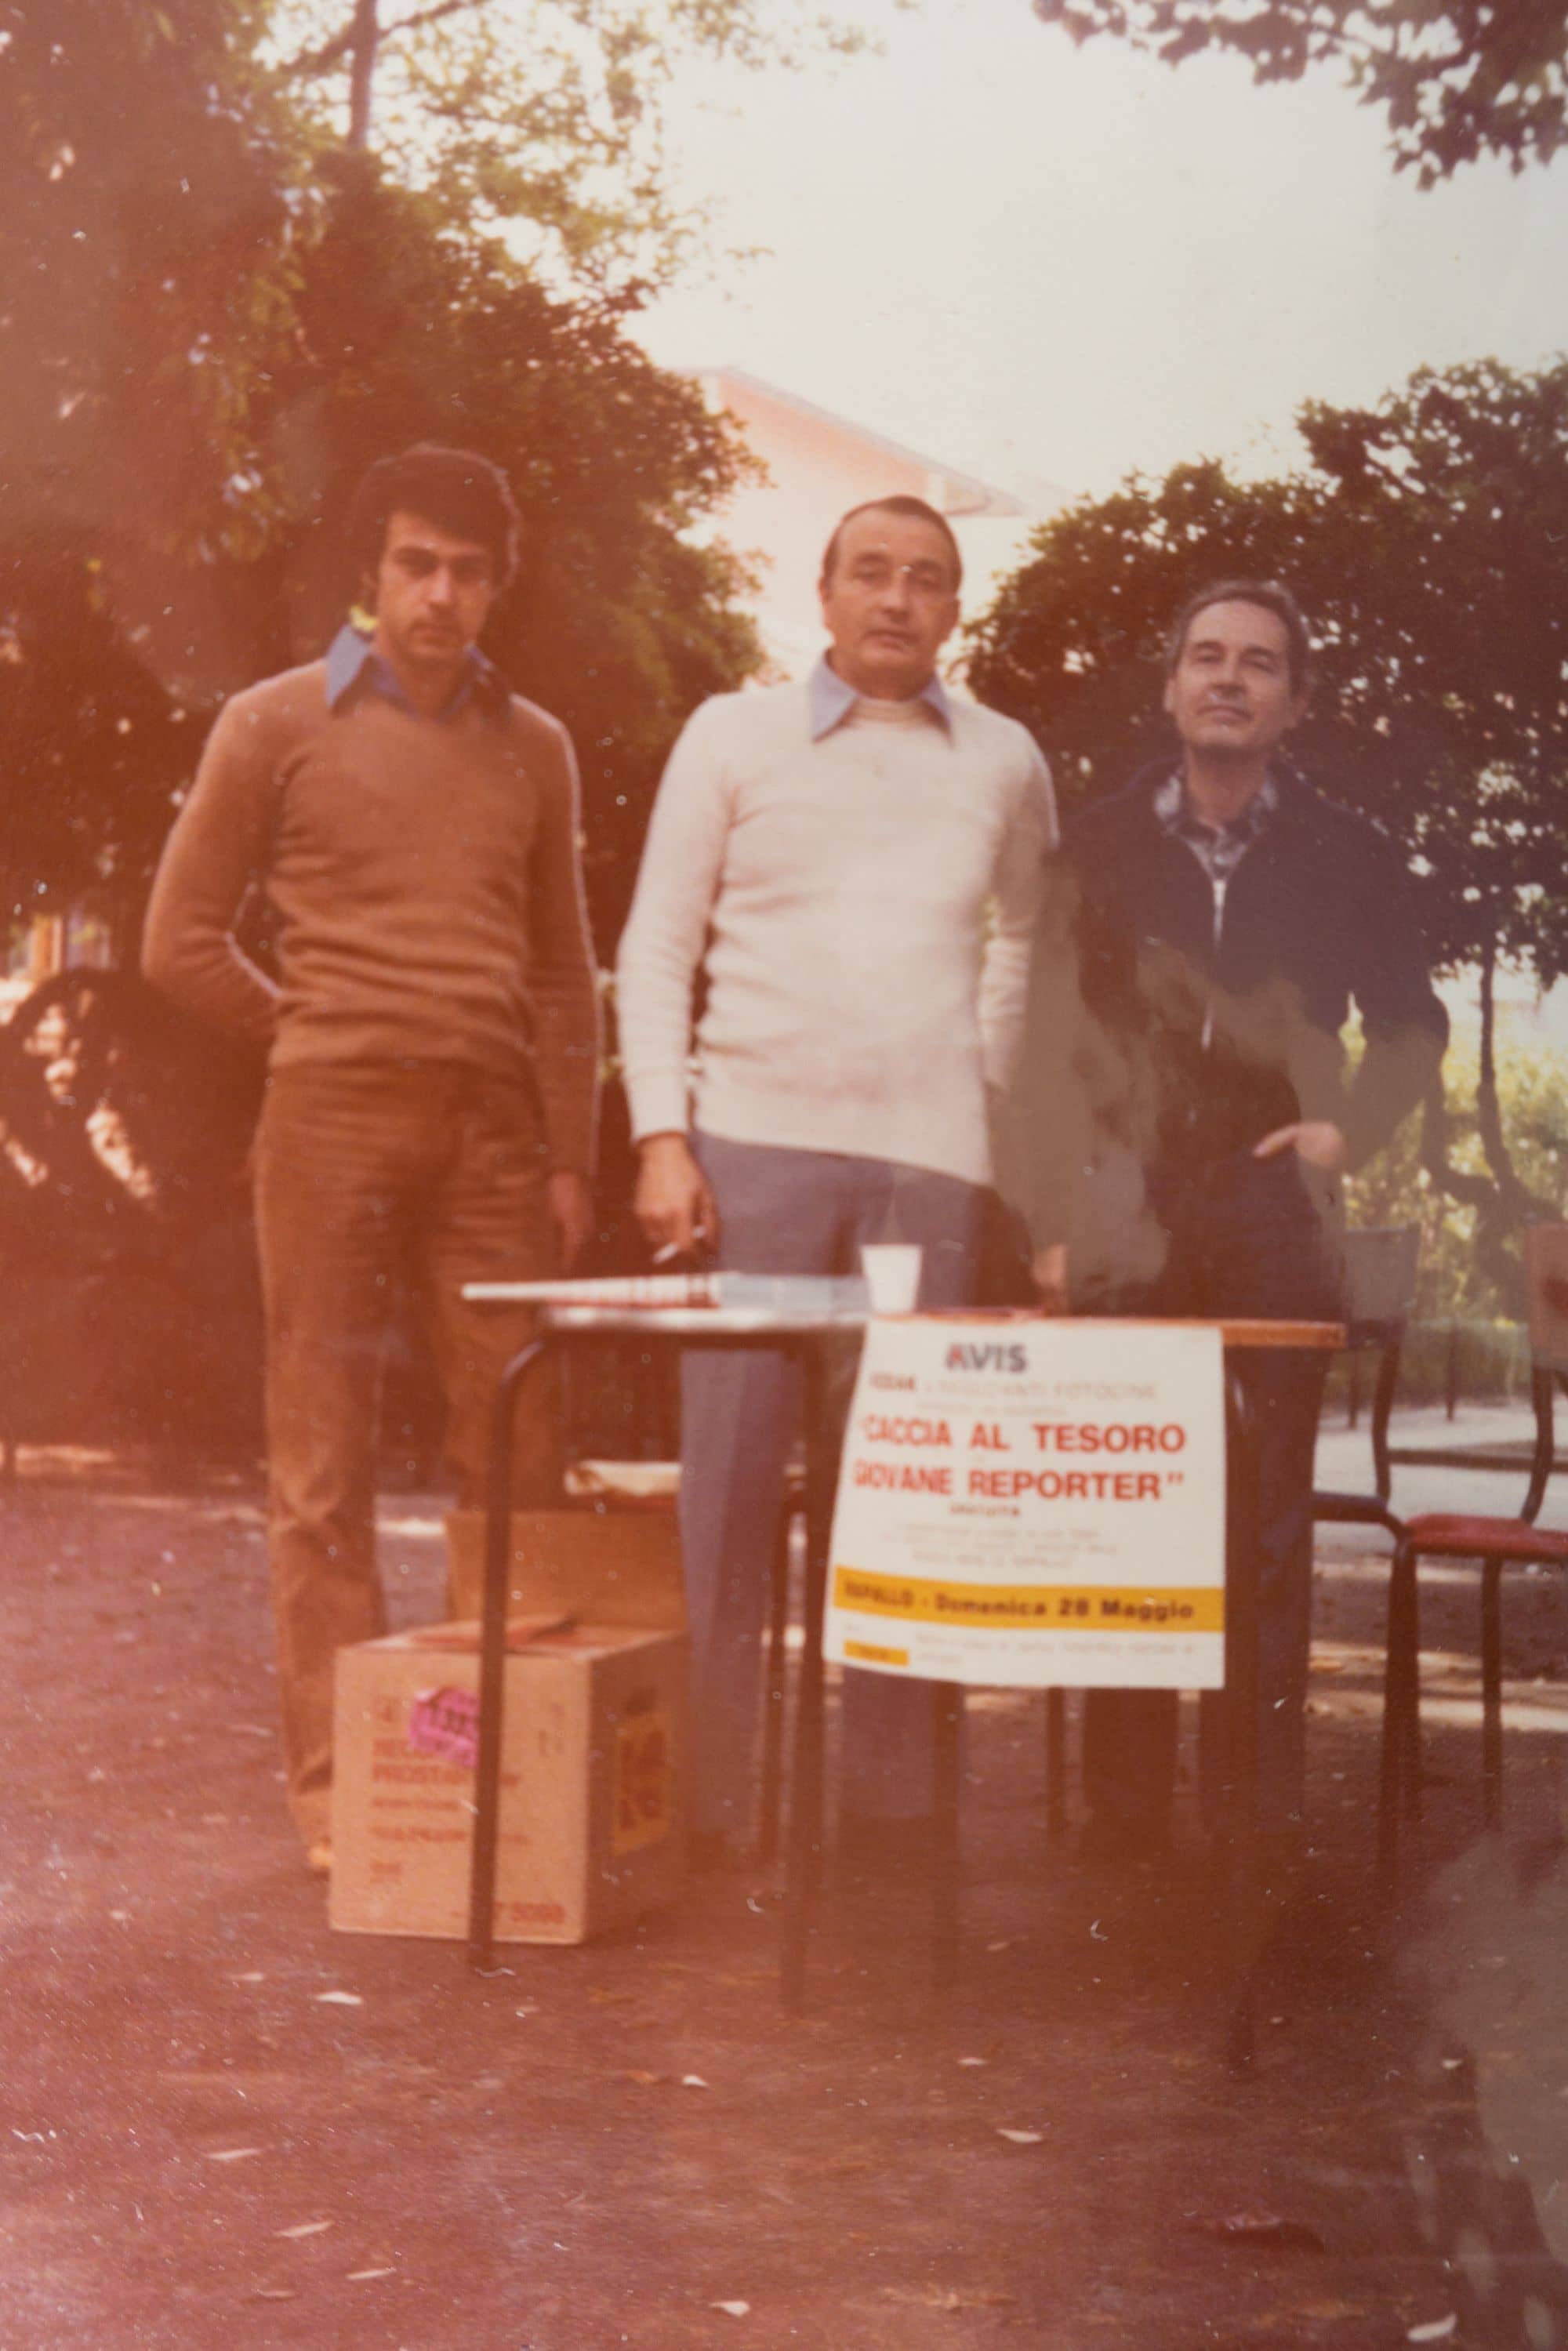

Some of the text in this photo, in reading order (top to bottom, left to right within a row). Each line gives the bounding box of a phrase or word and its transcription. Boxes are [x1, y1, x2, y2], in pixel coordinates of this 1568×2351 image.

[945, 1341, 1028, 1373] AVIS
[970, 1422, 1011, 1452] AL
[1031, 1422, 1186, 1453] TESORO
[935, 1591, 1047, 1616] Domenica
[1058, 1597, 1090, 1617] 28
[1101, 1598, 1196, 1623] Maggio
